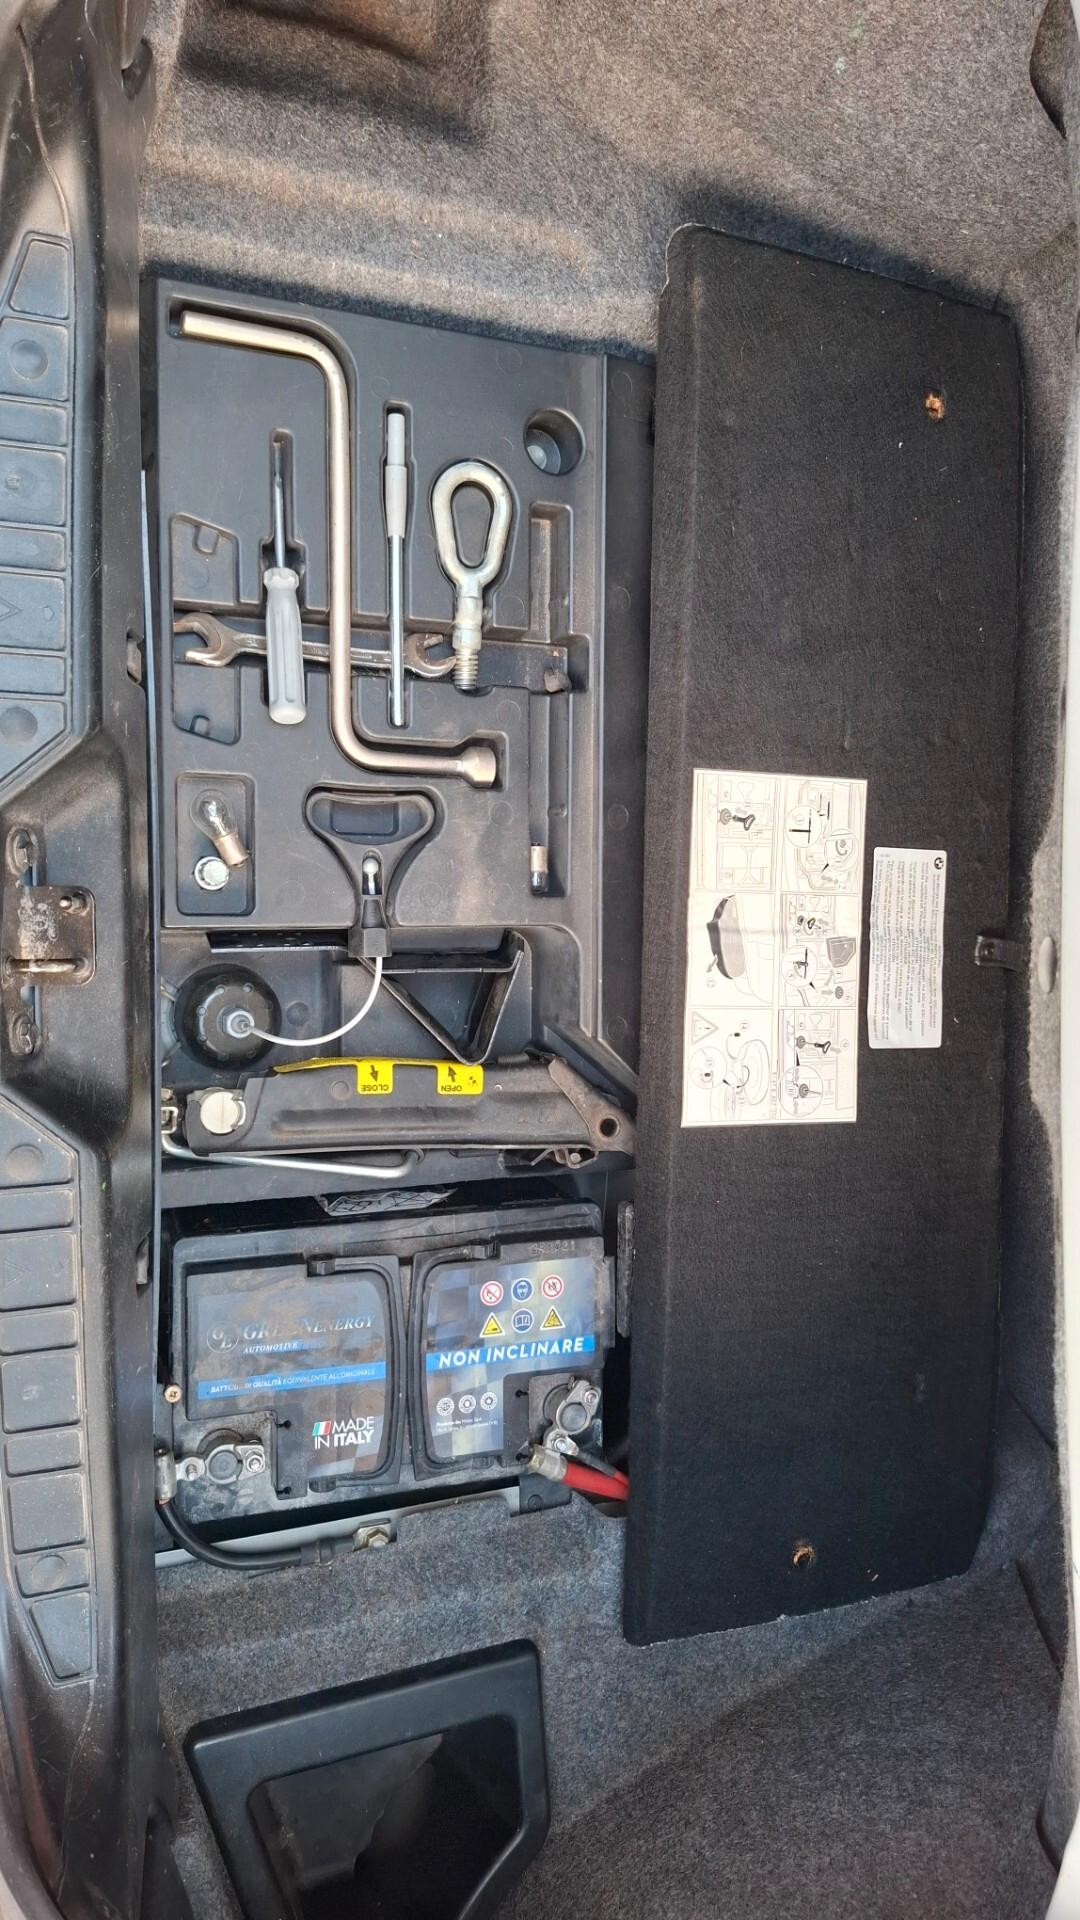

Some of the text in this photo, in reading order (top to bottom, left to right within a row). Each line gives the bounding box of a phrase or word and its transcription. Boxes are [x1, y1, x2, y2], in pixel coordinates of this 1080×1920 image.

[361, 1084, 389, 1092] CLOSE
[243, 1341, 299, 1354] AUTOMOTIVE
[439, 1336, 585, 1369] NON INCLINARE
[332, 1415, 375, 1434] MADE
[314, 1429, 375, 1450] IN ITALY
